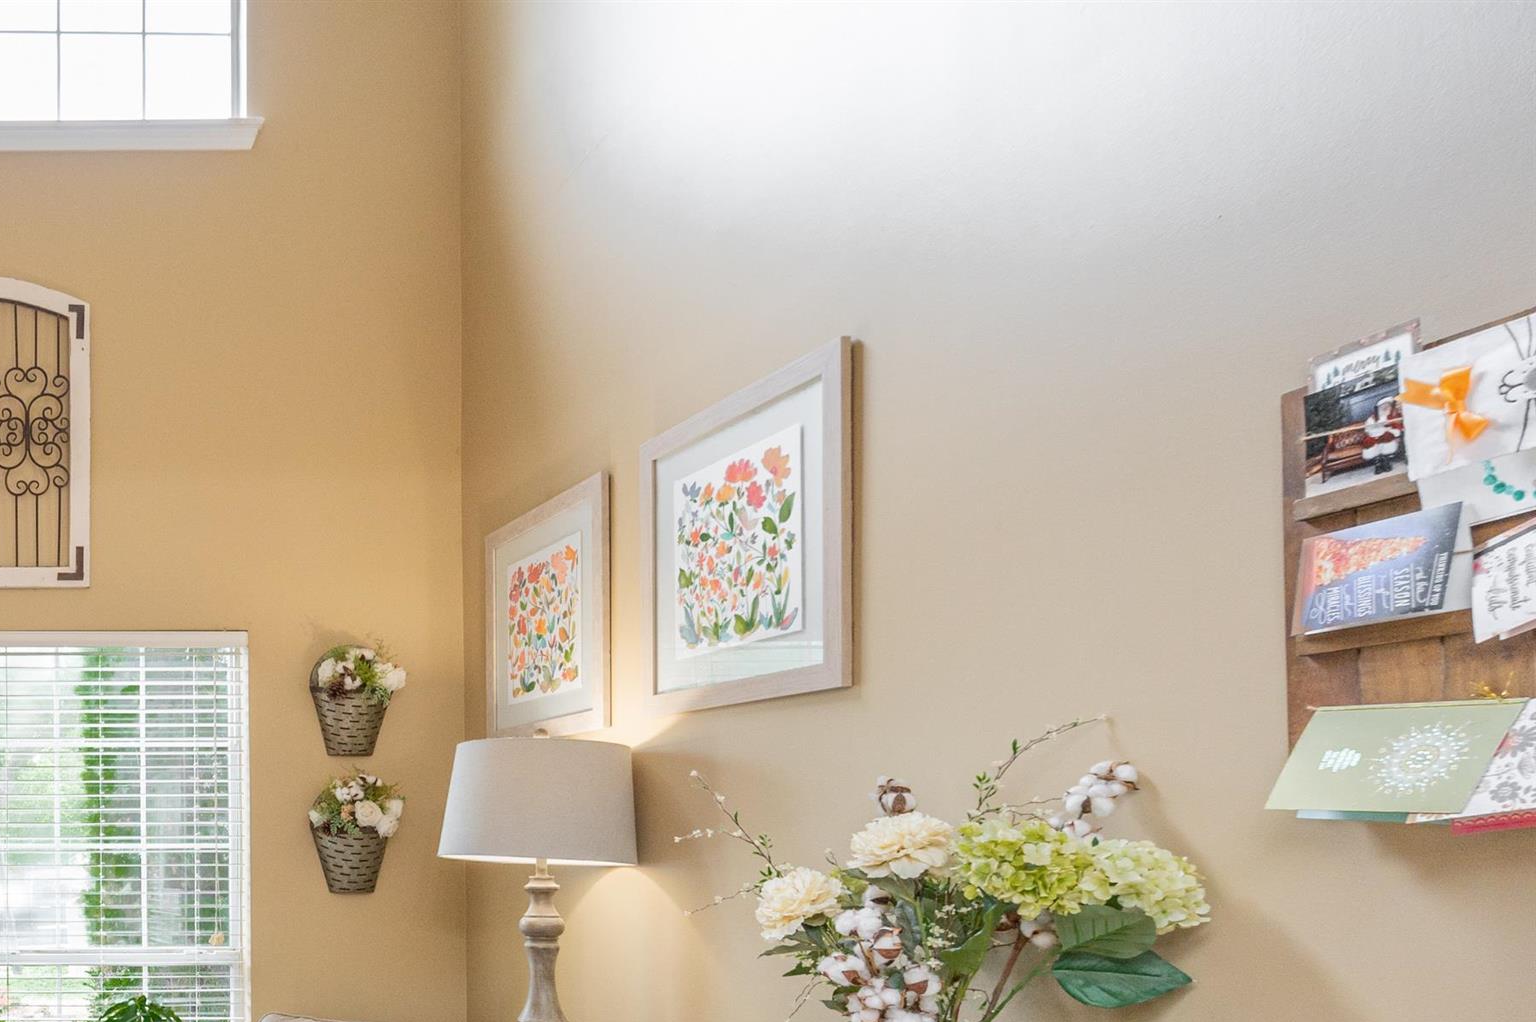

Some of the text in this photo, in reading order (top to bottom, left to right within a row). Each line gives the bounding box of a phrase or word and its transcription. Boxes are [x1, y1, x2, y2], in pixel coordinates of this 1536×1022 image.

[1357, 575, 1373, 617] BLESSINGS
[1393, 568, 1411, 607] SEASON
[1430, 593, 1441, 606] YOU
